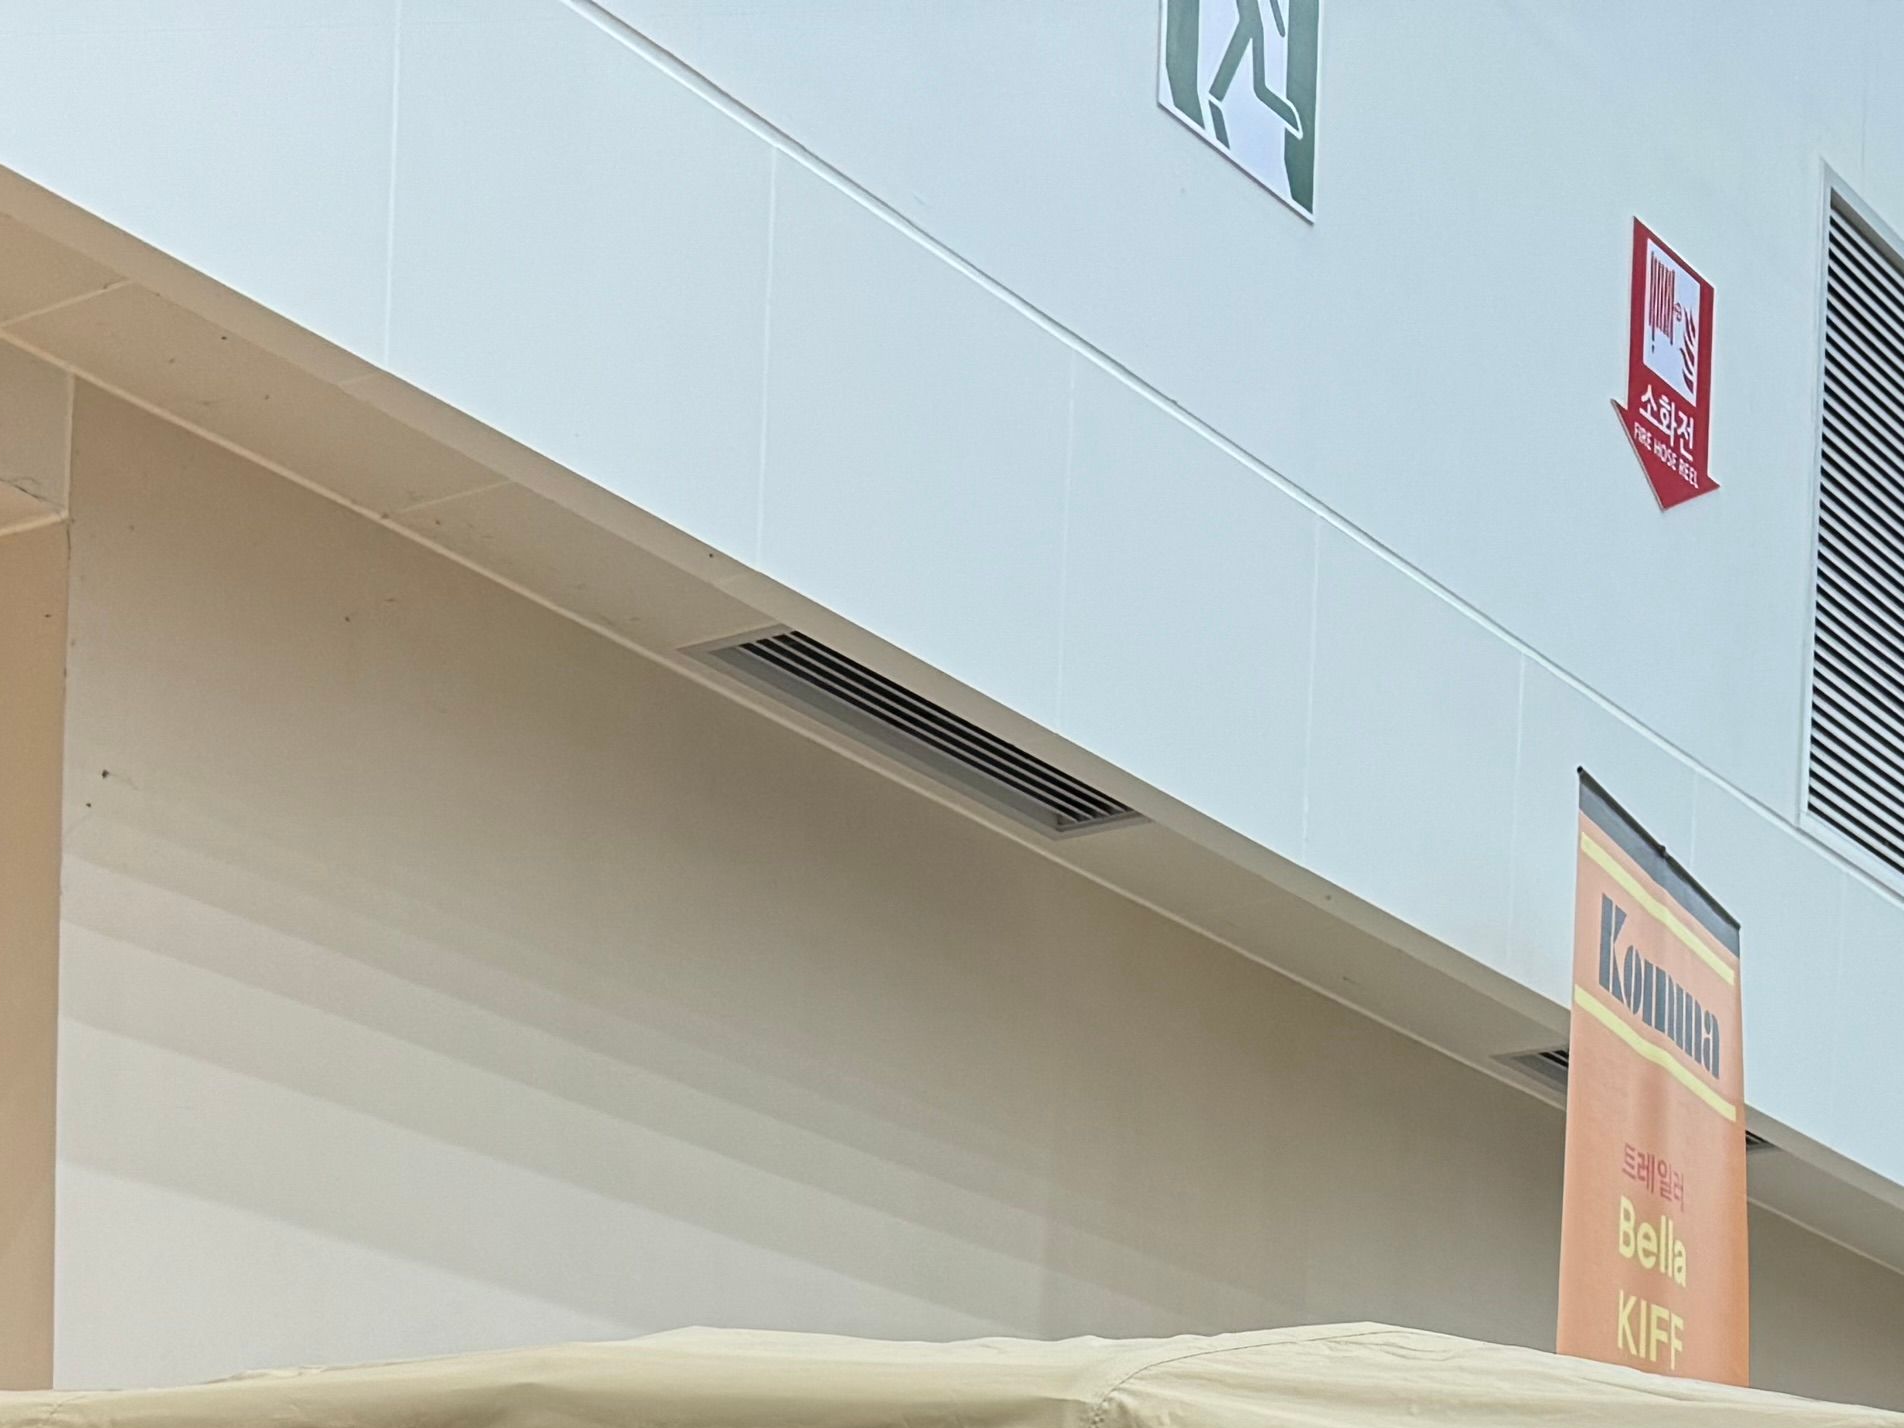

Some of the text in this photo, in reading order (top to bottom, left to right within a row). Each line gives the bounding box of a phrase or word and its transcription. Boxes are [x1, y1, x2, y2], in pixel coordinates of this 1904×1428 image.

[1634, 421, 1699, 489] FIRE HOSE REEL
[1639, 384, 1694, 462] 소화전
[1621, 1142, 1685, 1213] 트레일러
[1618, 1194, 1687, 1288] Bella
[1617, 1288, 1684, 1371] KIFF
